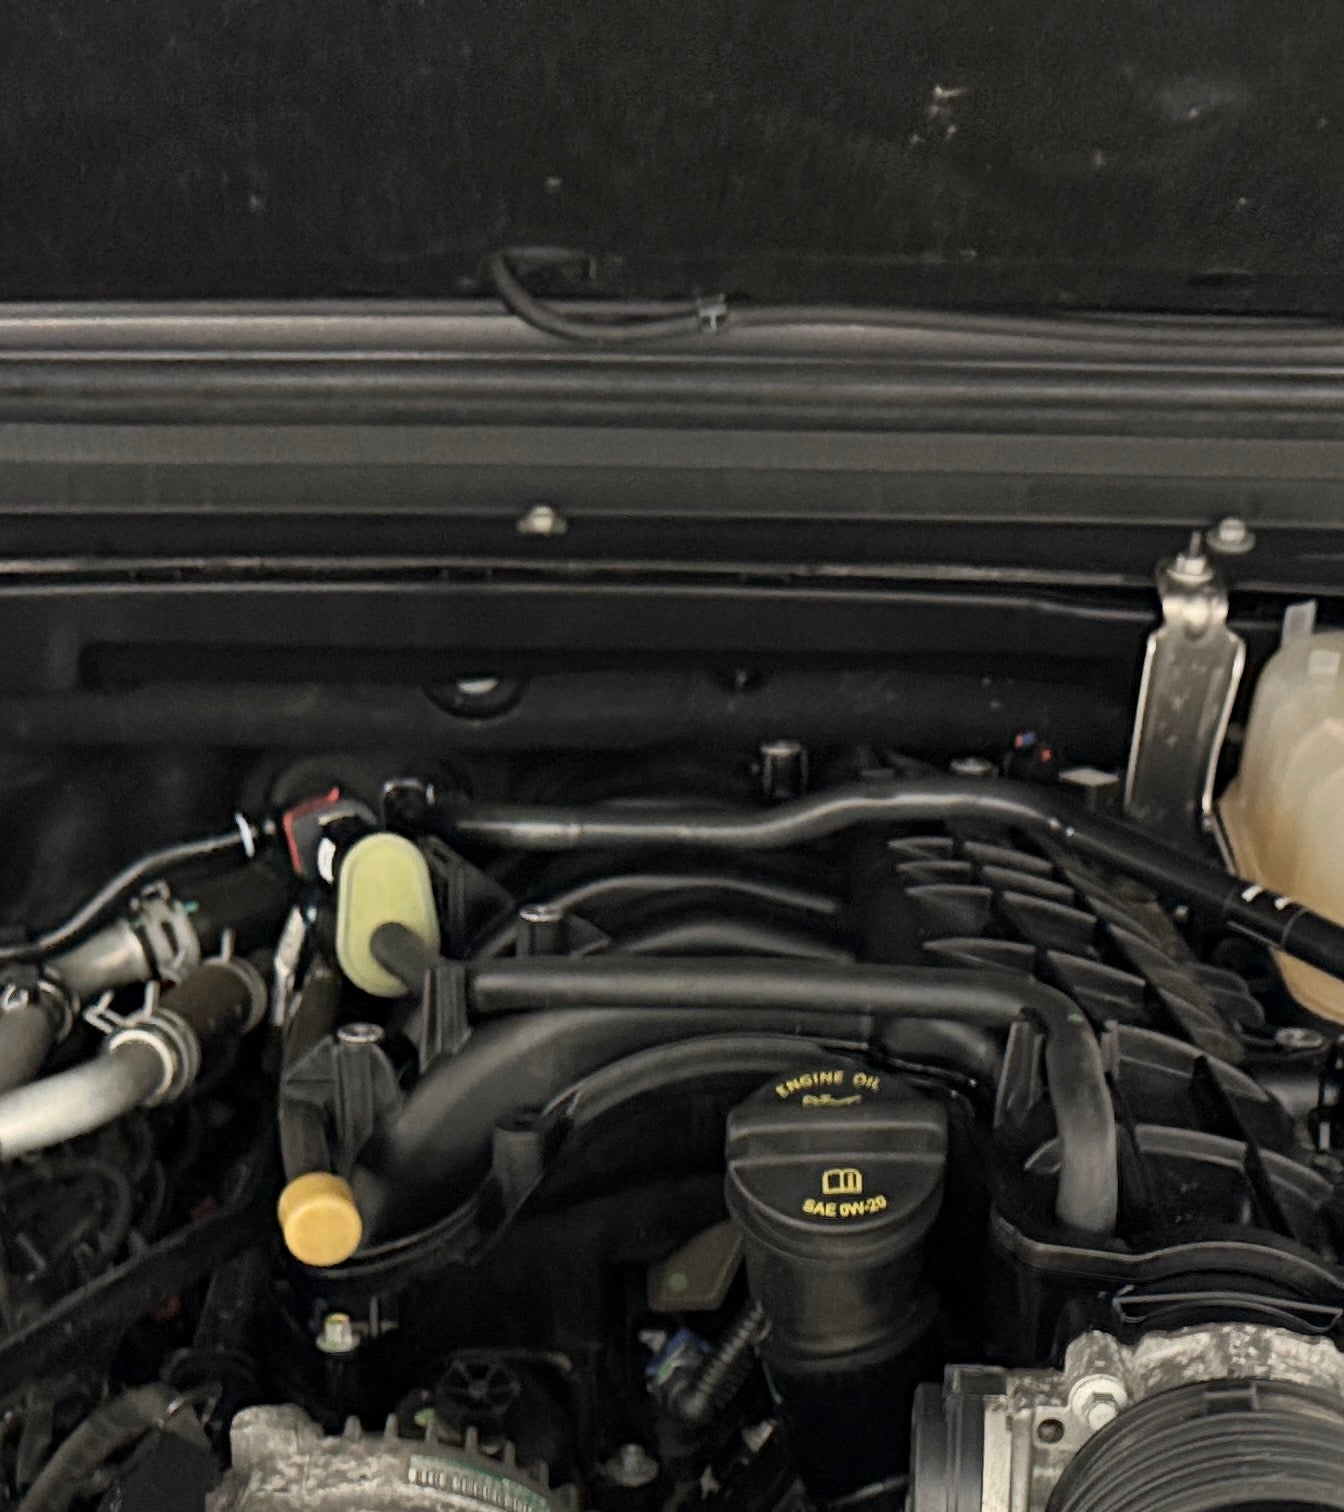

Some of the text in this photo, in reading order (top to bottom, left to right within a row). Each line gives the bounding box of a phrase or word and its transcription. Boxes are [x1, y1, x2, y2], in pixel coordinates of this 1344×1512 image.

[775, 1069, 881, 1099] ENGINE OIL
[802, 1194, 887, 1217] SAE 0W-20
